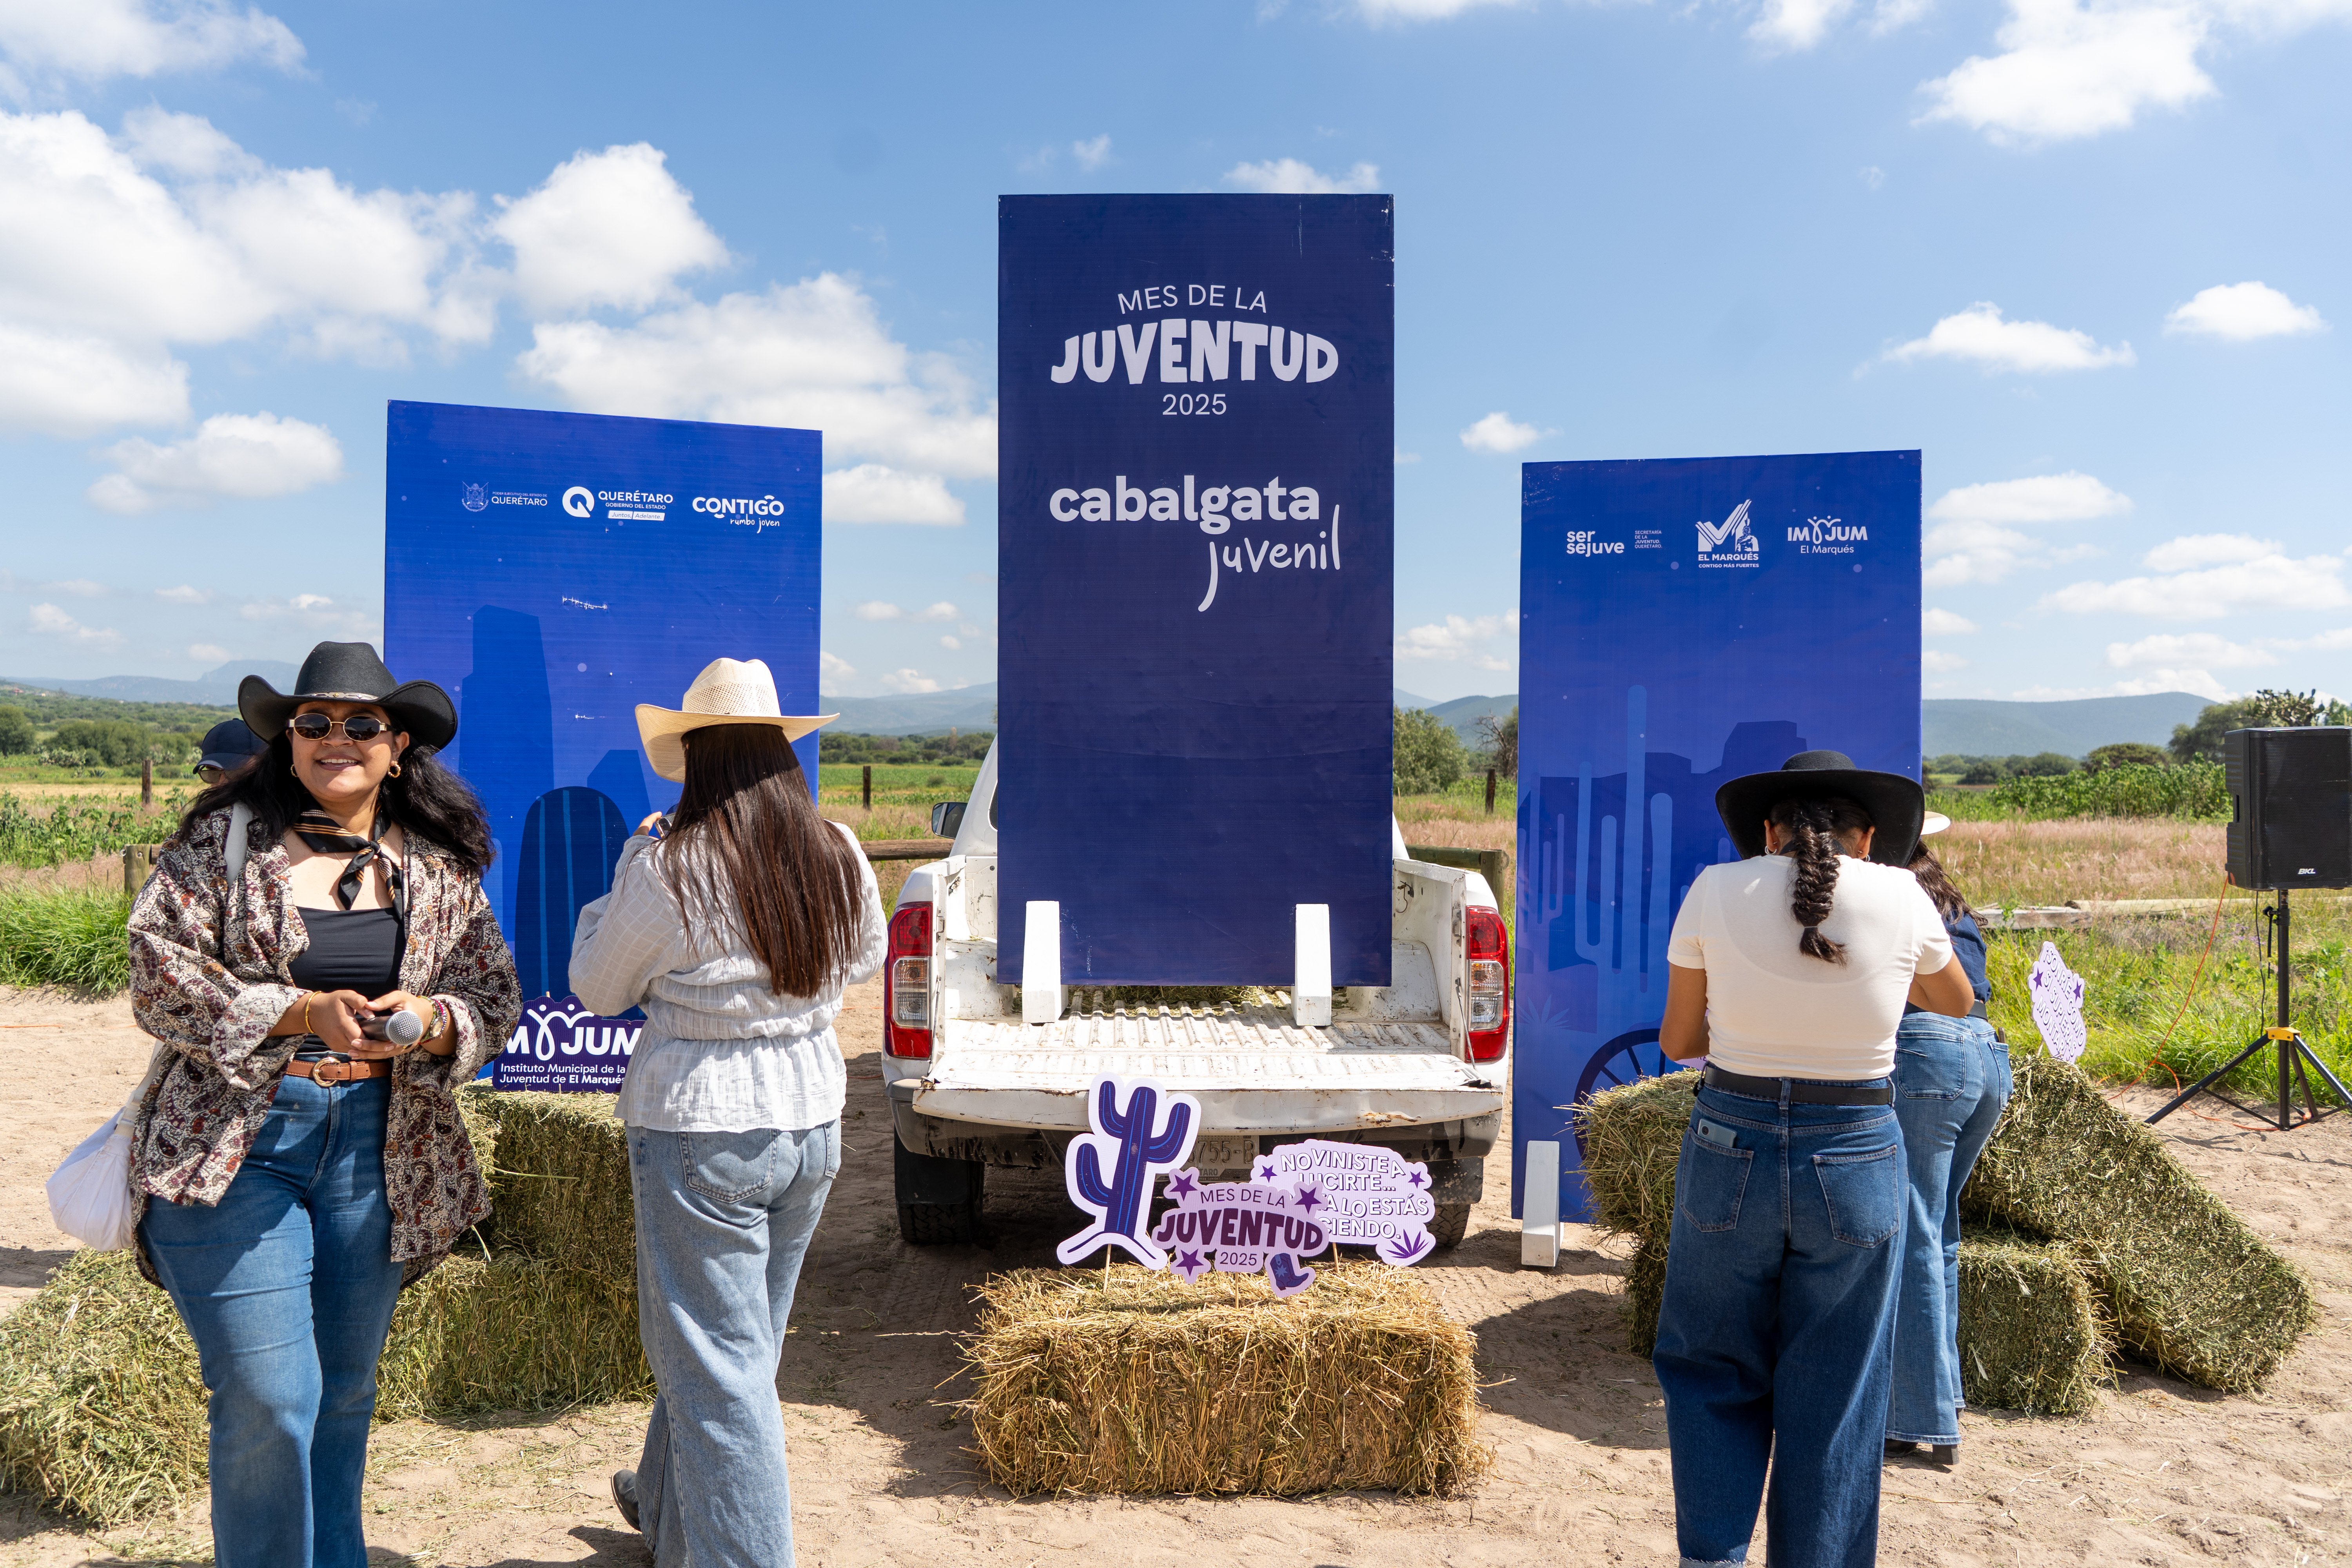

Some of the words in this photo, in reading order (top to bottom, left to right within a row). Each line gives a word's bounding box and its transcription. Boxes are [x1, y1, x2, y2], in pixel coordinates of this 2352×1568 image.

[1118, 285, 1179, 314] MES
[1189, 284, 1226, 307] DE
[1234, 287, 1267, 314] LA
[1051, 318, 1339, 385] JUVENTUD
[1162, 393, 1227, 416] 2025
[491, 496, 548, 506] QUERÉTARO
[598, 490, 673, 503] QUERÉTARO
[692, 496, 784, 517] CONTIGO
[1049, 475, 1319, 535] cabalgata
[730, 514, 755, 526] rumbo
[757, 518, 780, 534] joven
[1566, 531, 1595, 543] ser
[1198, 504, 1340, 612] juvenil
[1566, 542, 1624, 557] sejuve
[1712, 552, 1759, 561] MARQUÉS
[1800, 545, 1809, 554] El
[1812, 544, 1854, 555] Marqués
[2043, 969, 2053, 991] SI
[2050, 986, 2076, 1057] SUPIERAS
[2067, 997, 2085, 1046] COMO
[500, 1074, 550, 1083] Juventud
[553, 1074, 566, 1083] de
[569, 1074, 579, 1083] El
[501, 1063, 545, 1073] Instituto
[548, 1063, 598, 1075] Municipal
[601, 1064, 614, 1073] de
[617, 1065, 626, 1073] la
[1280, 1152, 1312, 1172] NO
[1311, 1149, 1389, 1173] VINISTE
[1391, 1160, 1406, 1178] A
[1200, 1188, 1235, 1204] MES
[1241, 1189, 1263, 1203] DE
[1267, 1192, 1285, 1209] LA
[1318, 1193, 1338, 1212] A
[1341, 1197, 1367, 1218] LO
[1369, 1193, 1429, 1215] ESTÁS
[1156, 1207, 1323, 1250] JUVENTUD
[1318, 1216, 1401, 1239] CIENDO.
[1220, 1252, 1257, 1266] 2025
